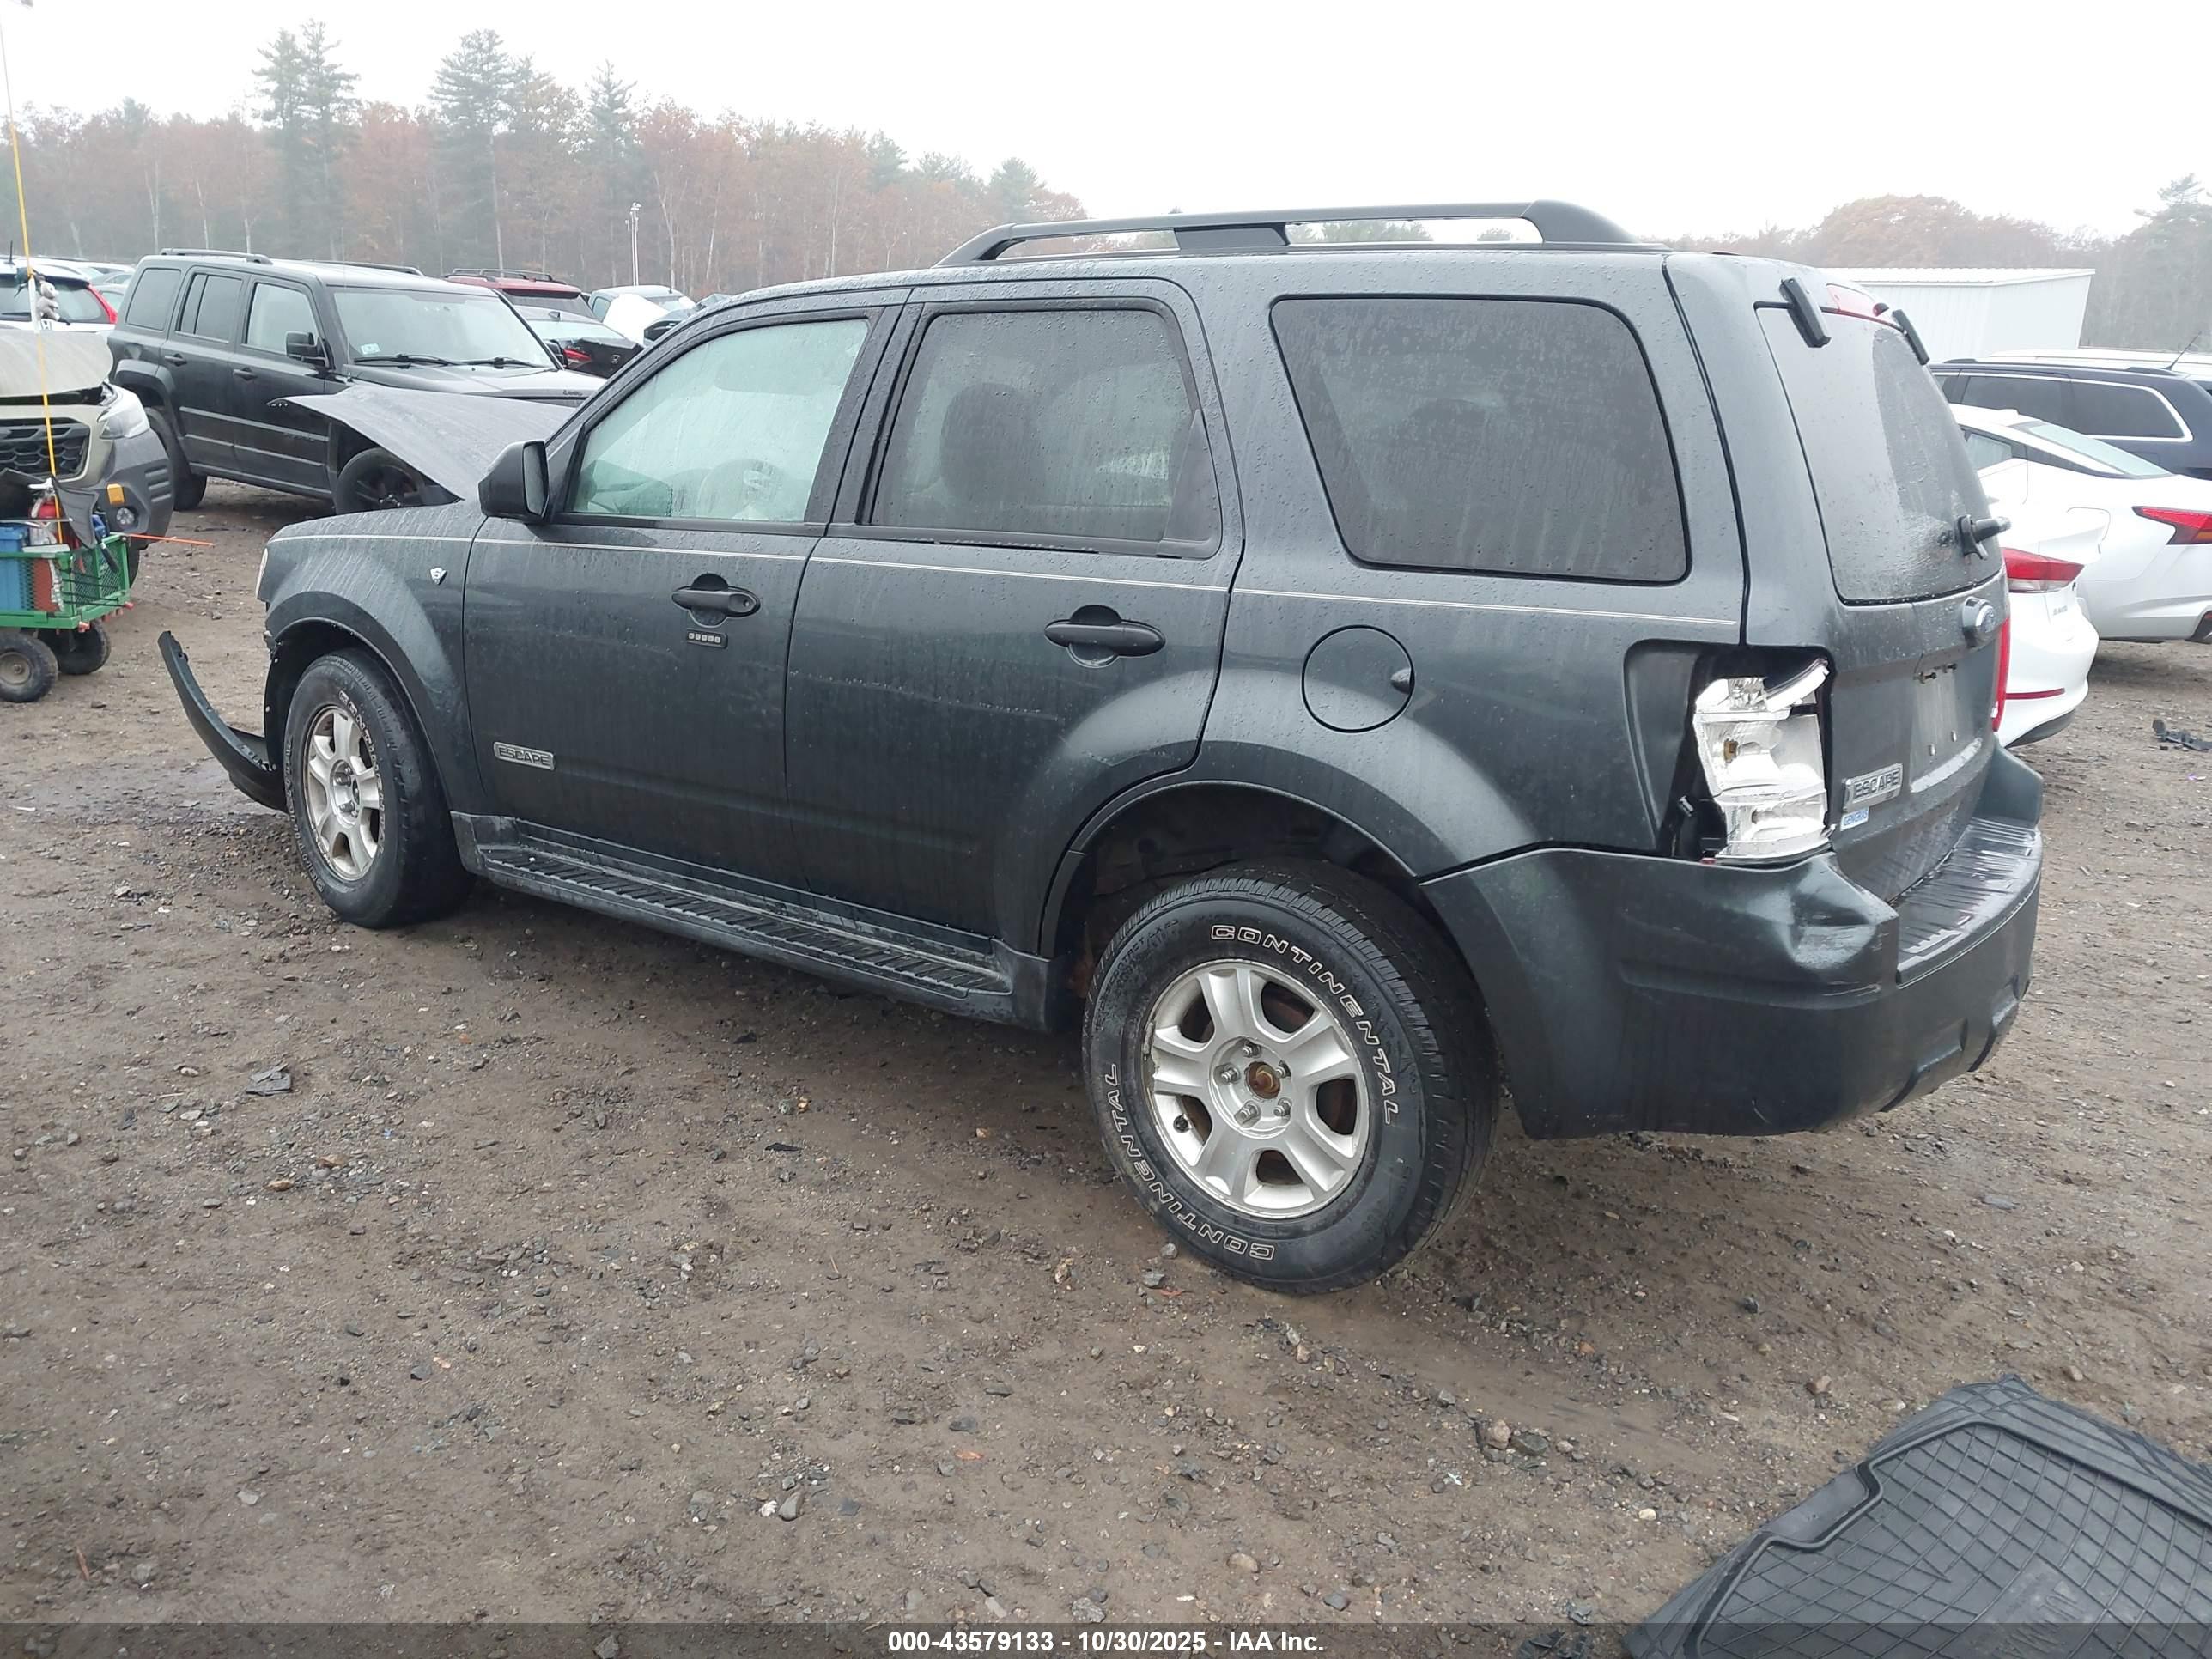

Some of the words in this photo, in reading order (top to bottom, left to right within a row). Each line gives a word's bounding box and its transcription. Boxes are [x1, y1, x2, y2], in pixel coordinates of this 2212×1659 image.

[498, 744, 550, 766] ESCAPE
[1854, 768, 1900, 799] ESCAPE
[1211, 925, 1400, 1125] CONTINENTAL
[1104, 1064, 1276, 1261] CONTINENTAL
